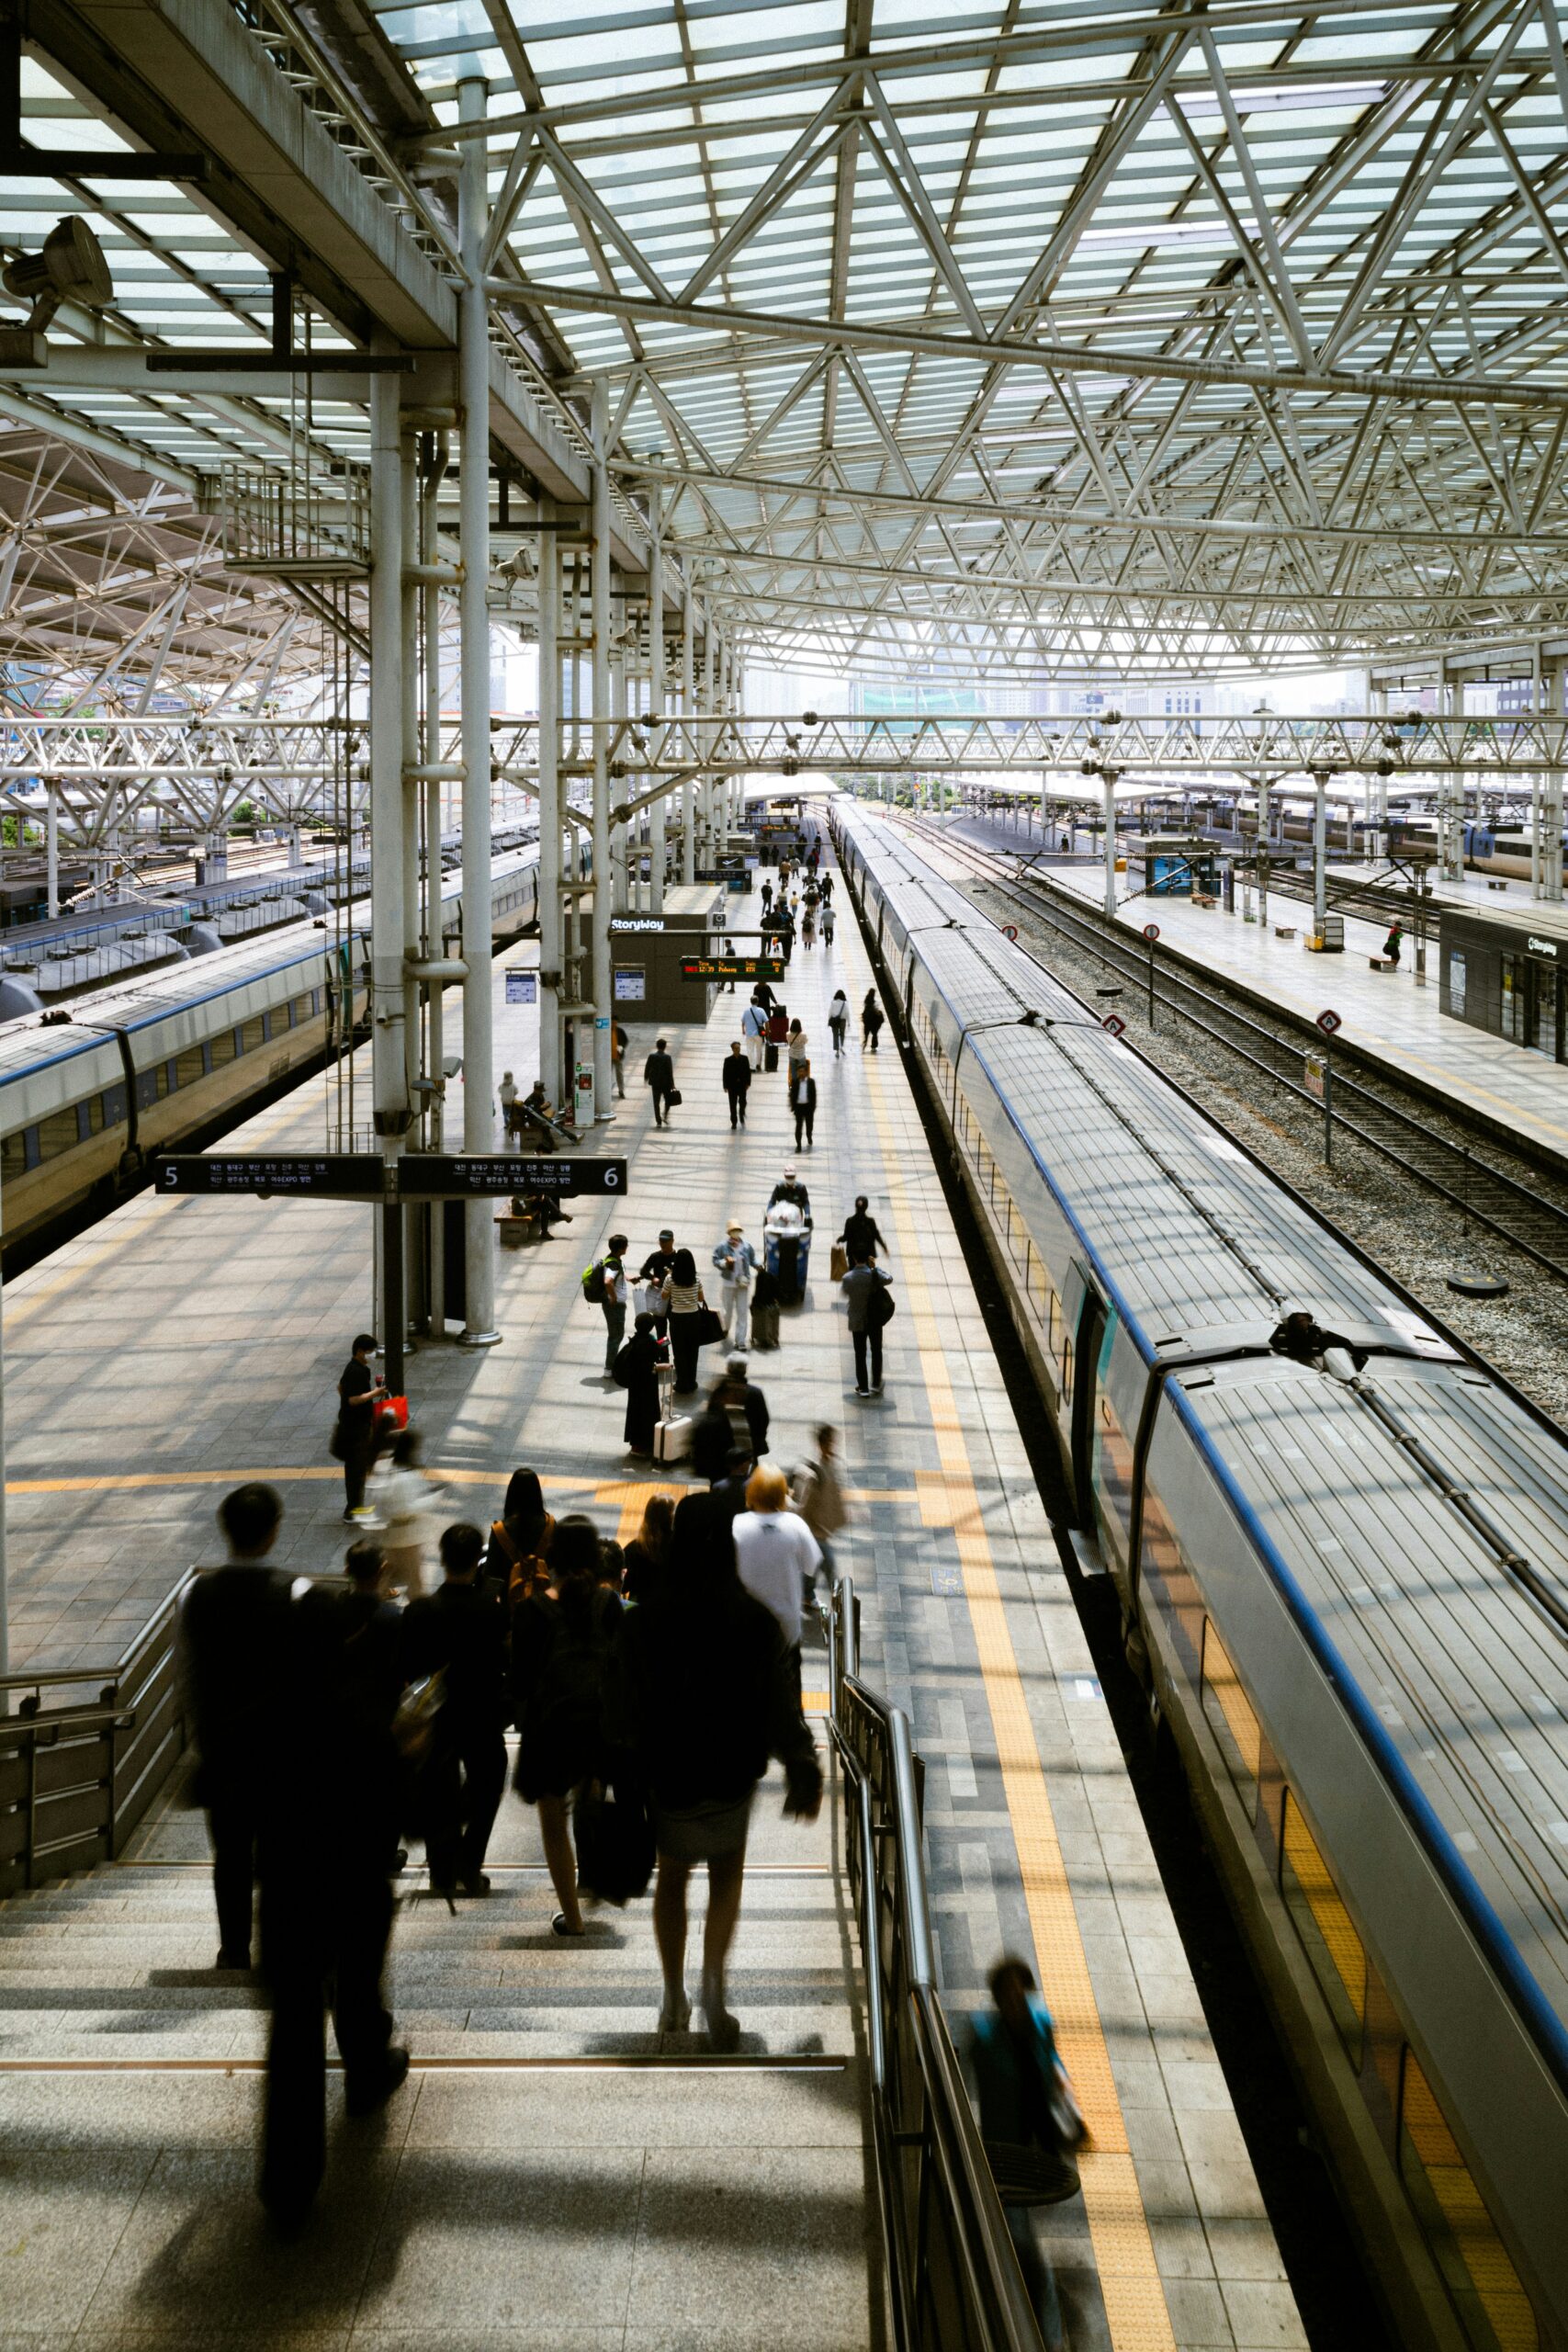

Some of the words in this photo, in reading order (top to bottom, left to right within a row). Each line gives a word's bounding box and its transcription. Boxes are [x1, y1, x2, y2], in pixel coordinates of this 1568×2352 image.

[1110, 1021, 1117, 1030] A
[1325, 1016, 1333, 1025] A
[165, 1167, 178, 1186] 5
[604, 1167, 618, 1186] 6
